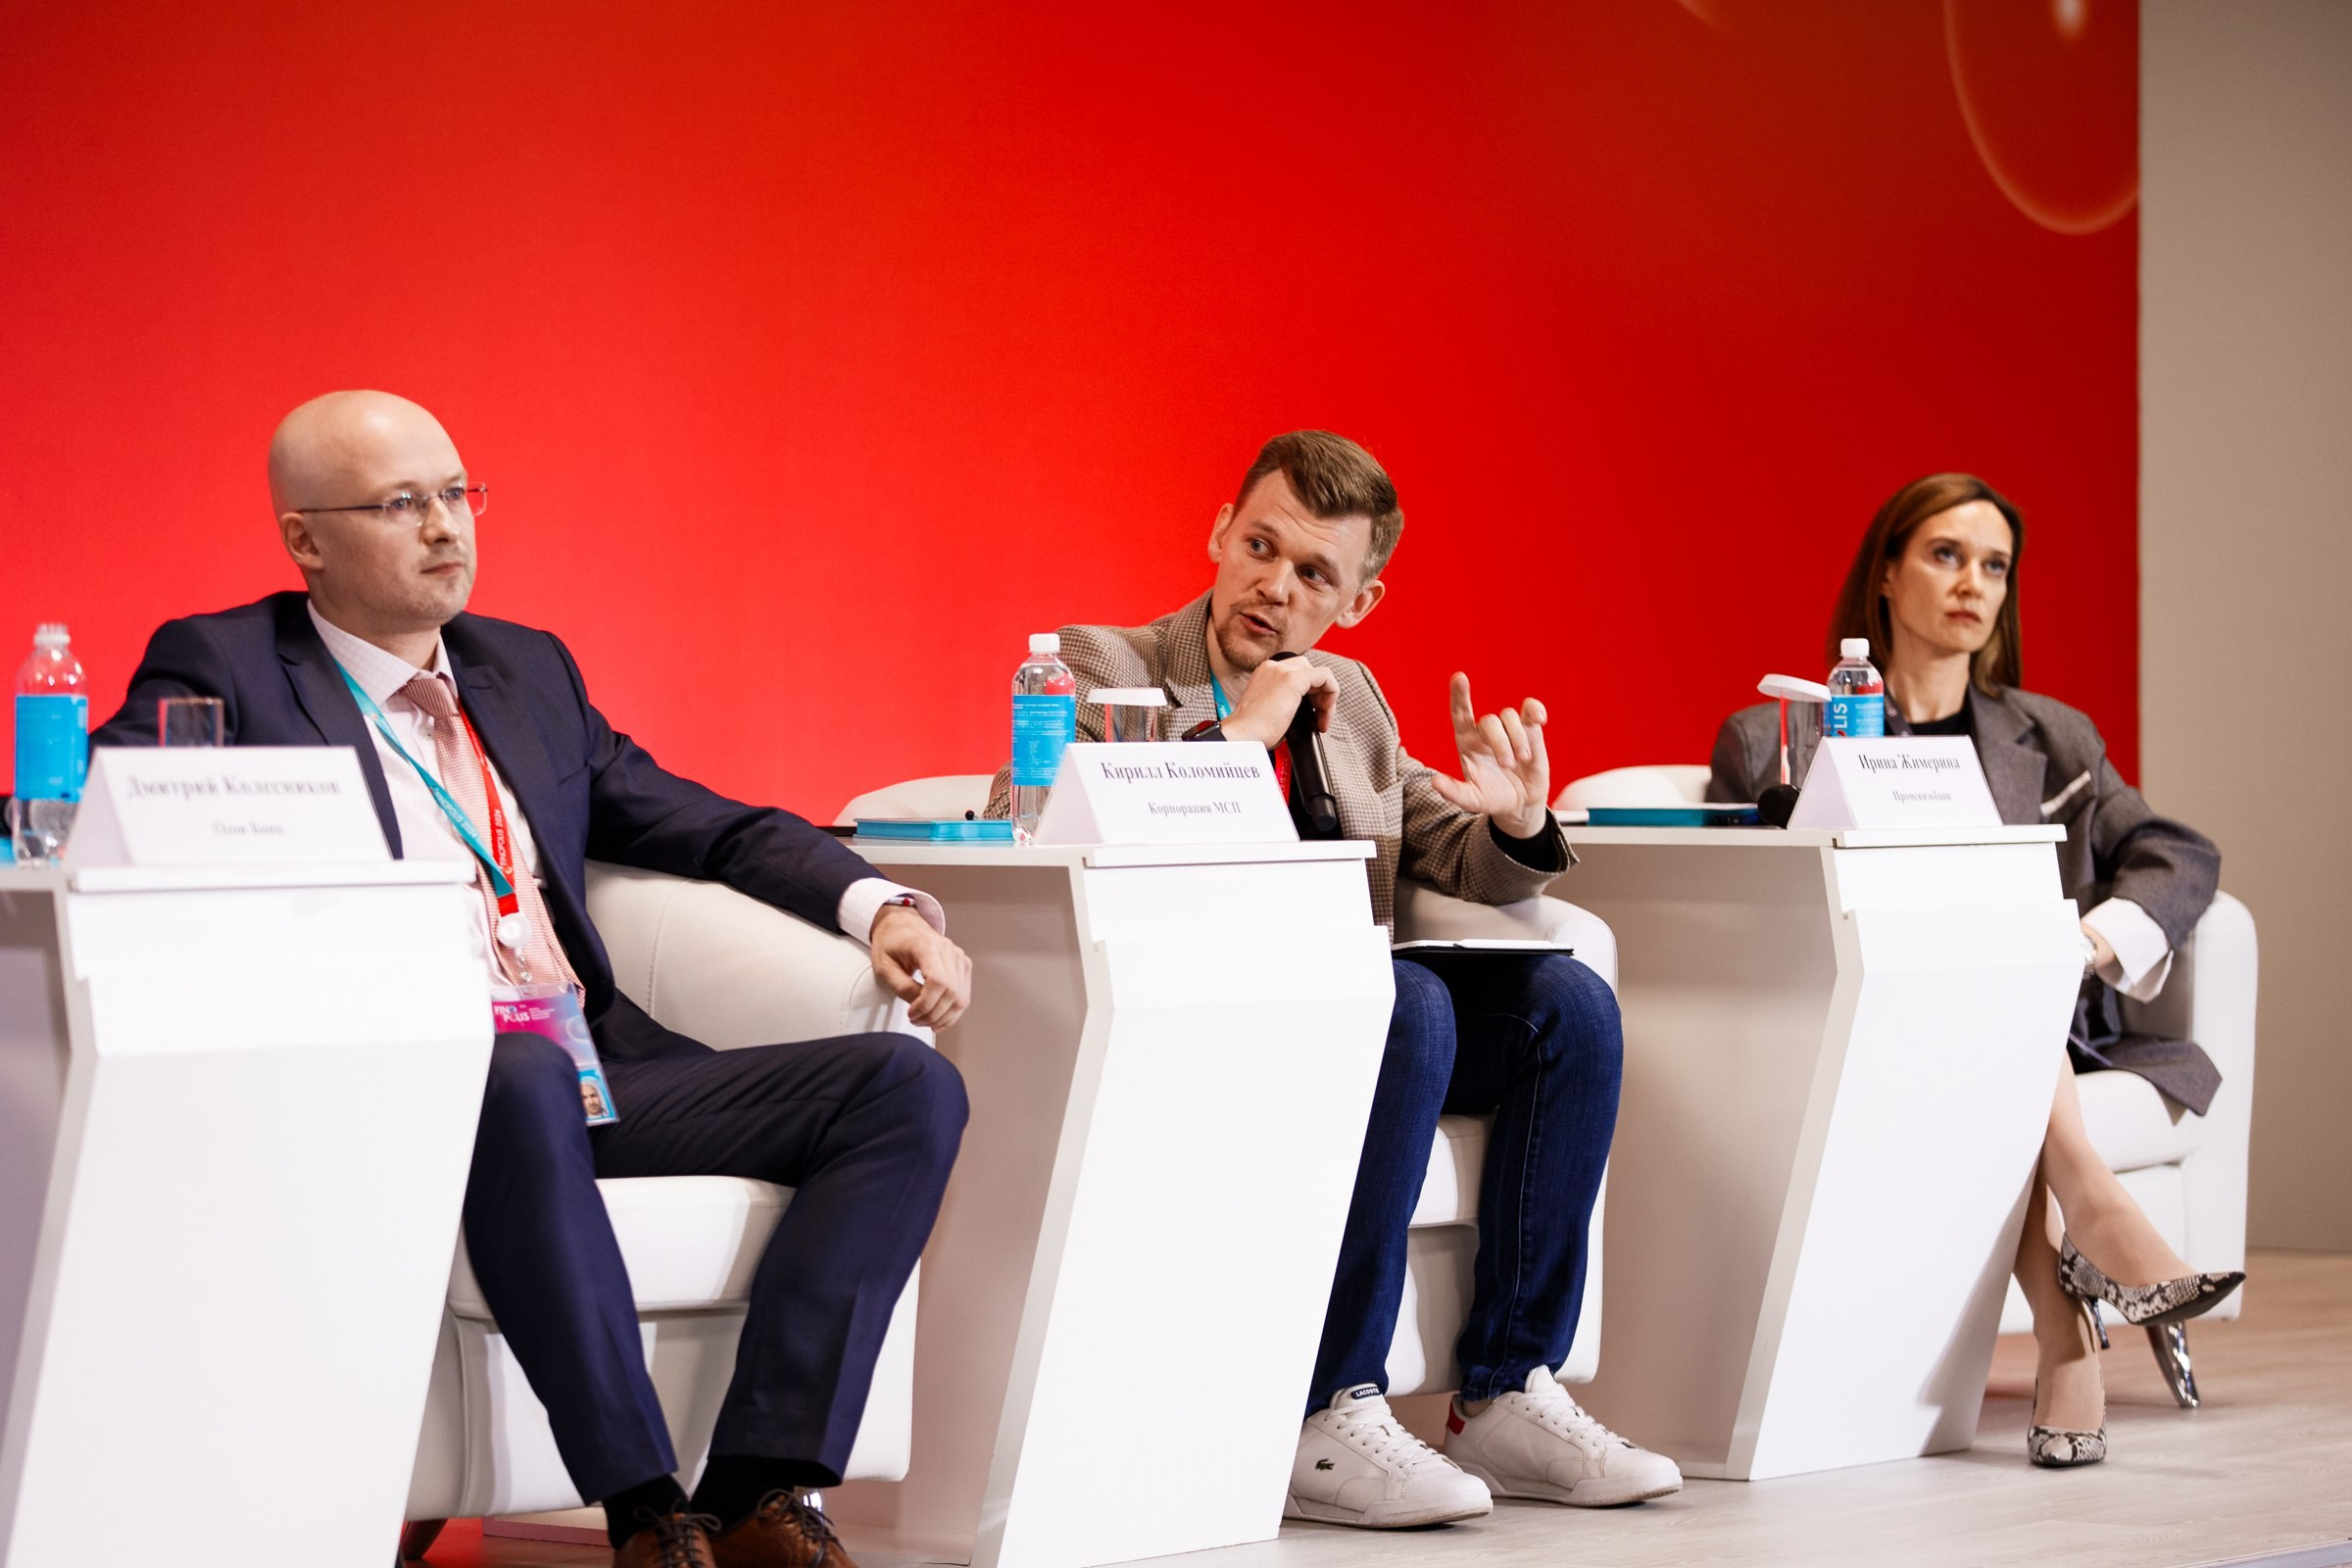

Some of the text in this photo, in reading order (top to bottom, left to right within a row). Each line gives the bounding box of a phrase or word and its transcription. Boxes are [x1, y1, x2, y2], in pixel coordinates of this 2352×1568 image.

[1101, 761, 1260, 783] Кирилл Коломийцев
[1858, 754, 1961, 773] Ирина Жимерина
[128, 775, 343, 801] Дмитрий Колесников
[1148, 802, 1242, 817] Корпорация МСП
[496, 829, 507, 866] FINOPOLIS
